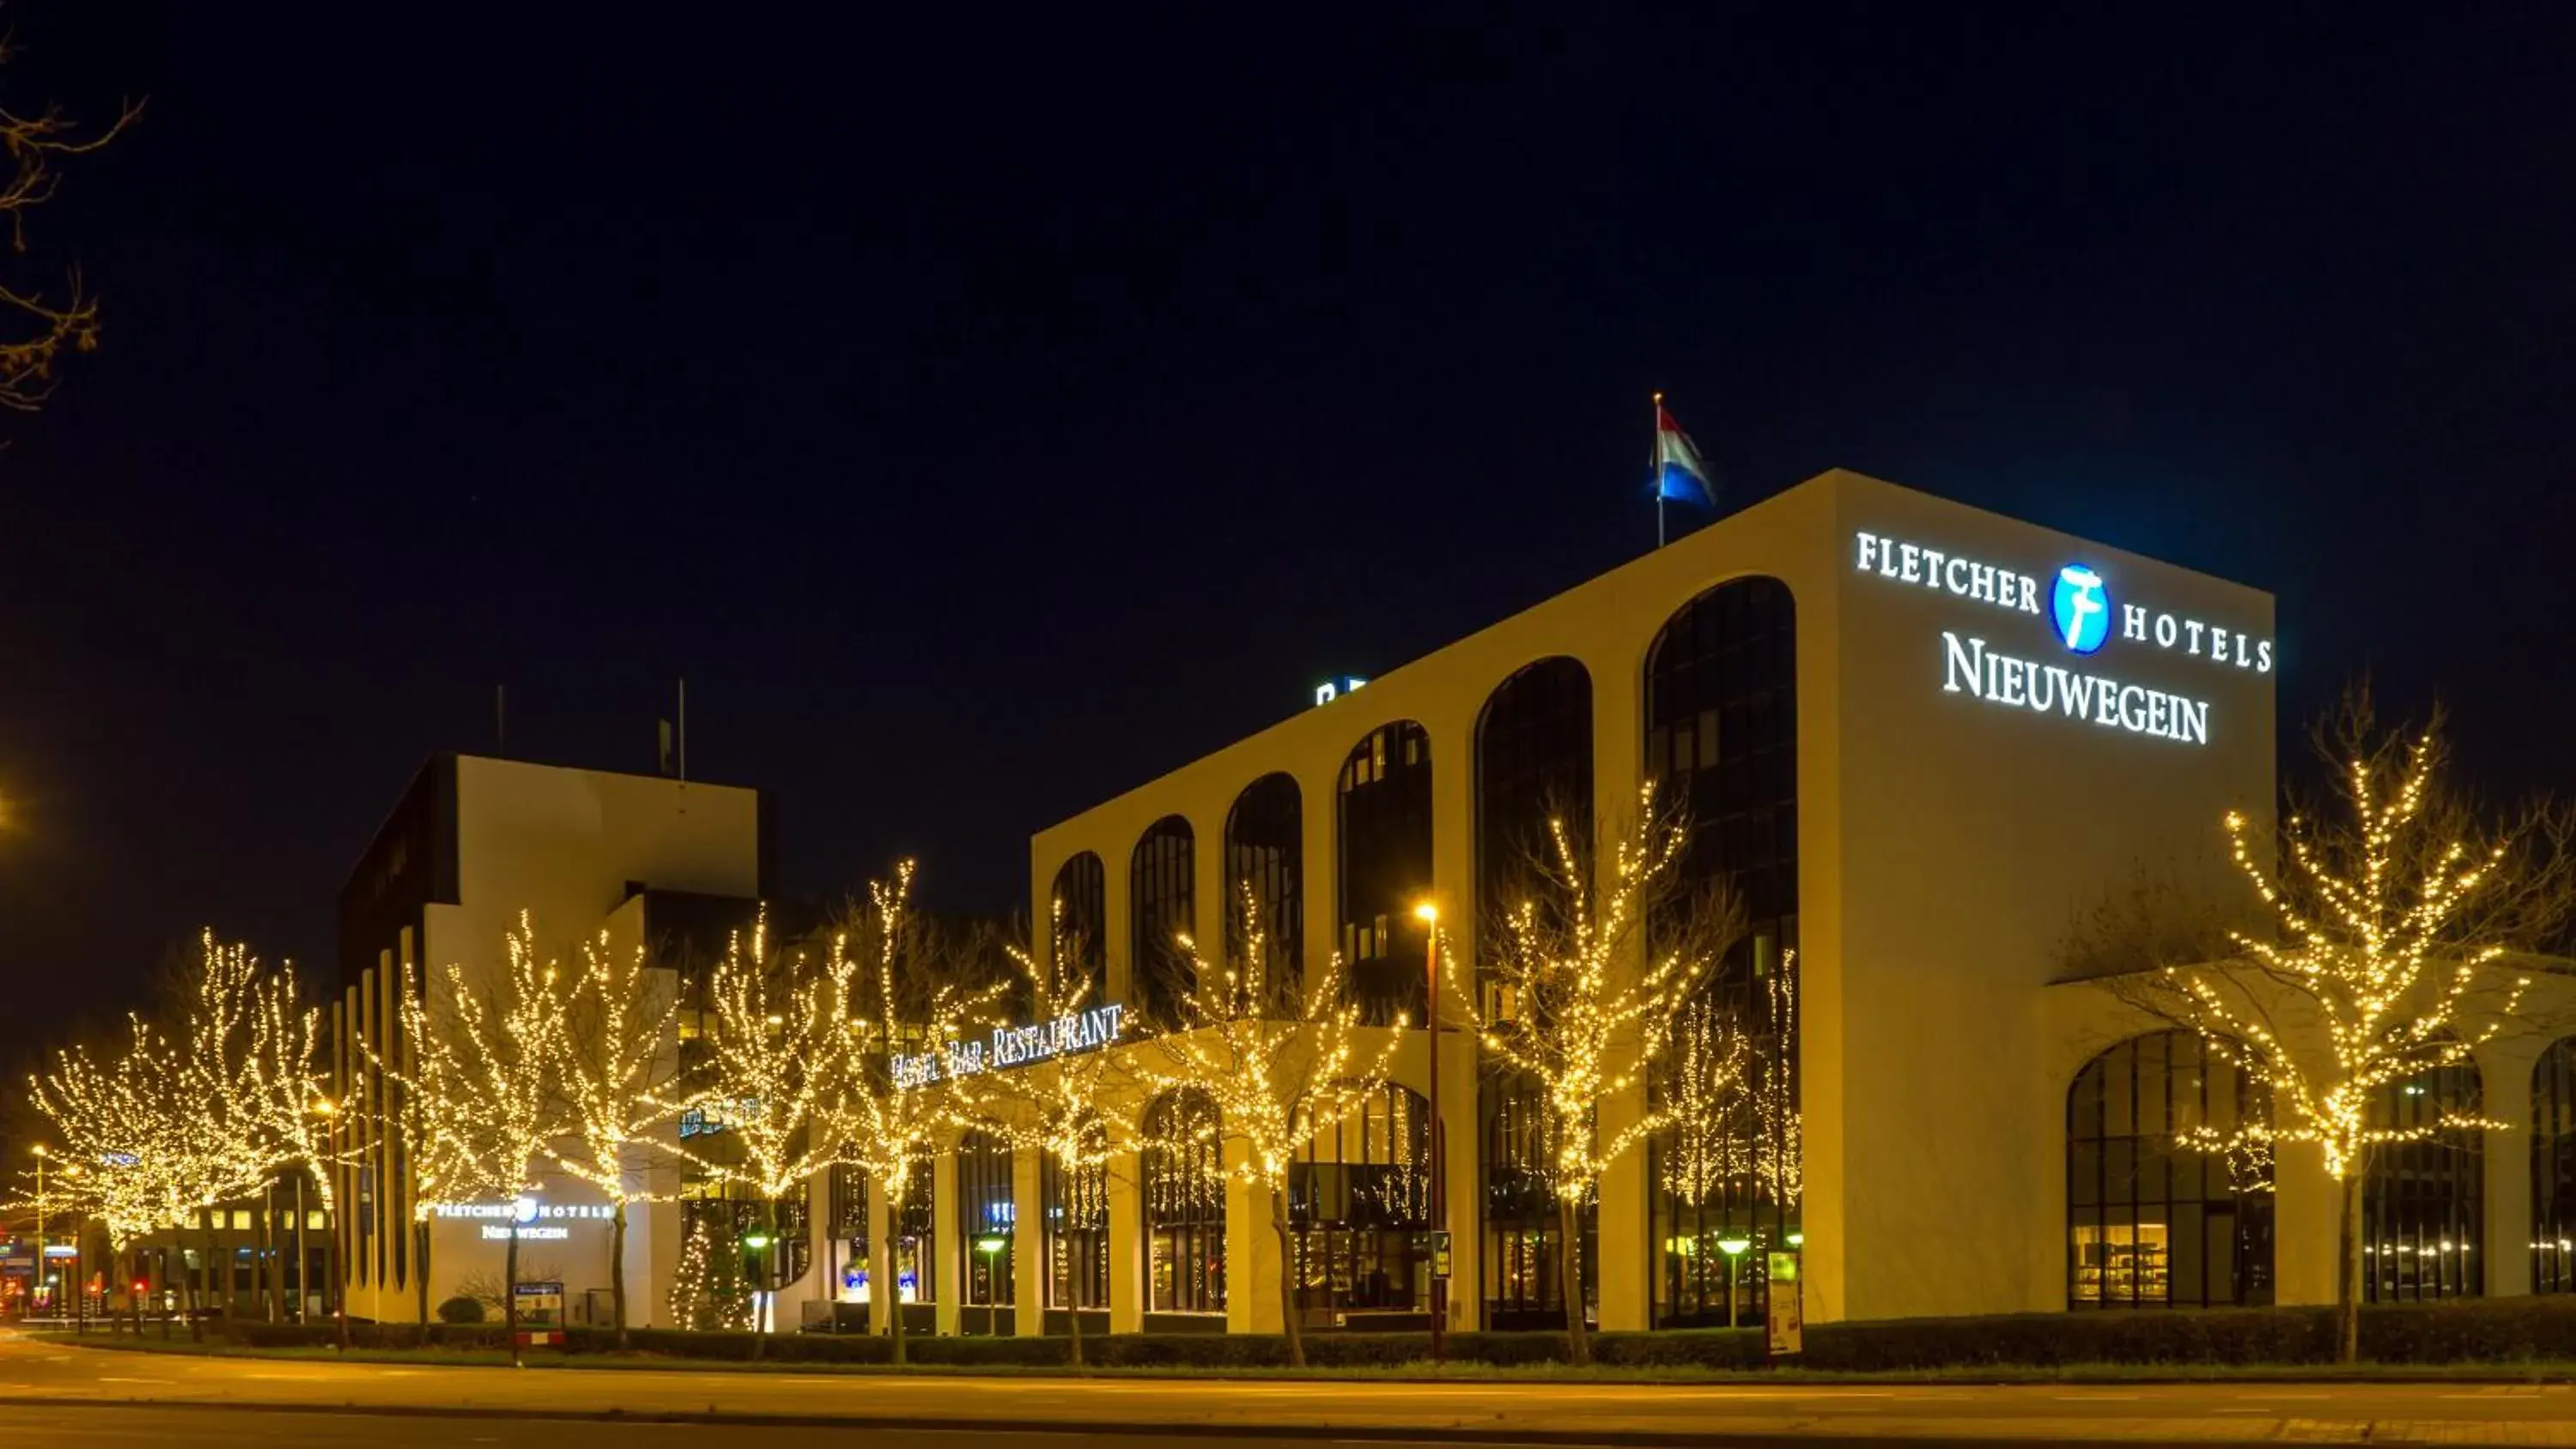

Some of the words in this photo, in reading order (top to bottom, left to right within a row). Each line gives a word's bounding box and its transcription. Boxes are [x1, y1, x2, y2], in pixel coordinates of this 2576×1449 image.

[1856, 531, 2040, 615] FLETCHER
[2123, 603, 2272, 673] HOTELS
[1941, 632, 2209, 745] NIEUWEGEIN
[992, 1003, 1123, 1068] RESTAURANT
